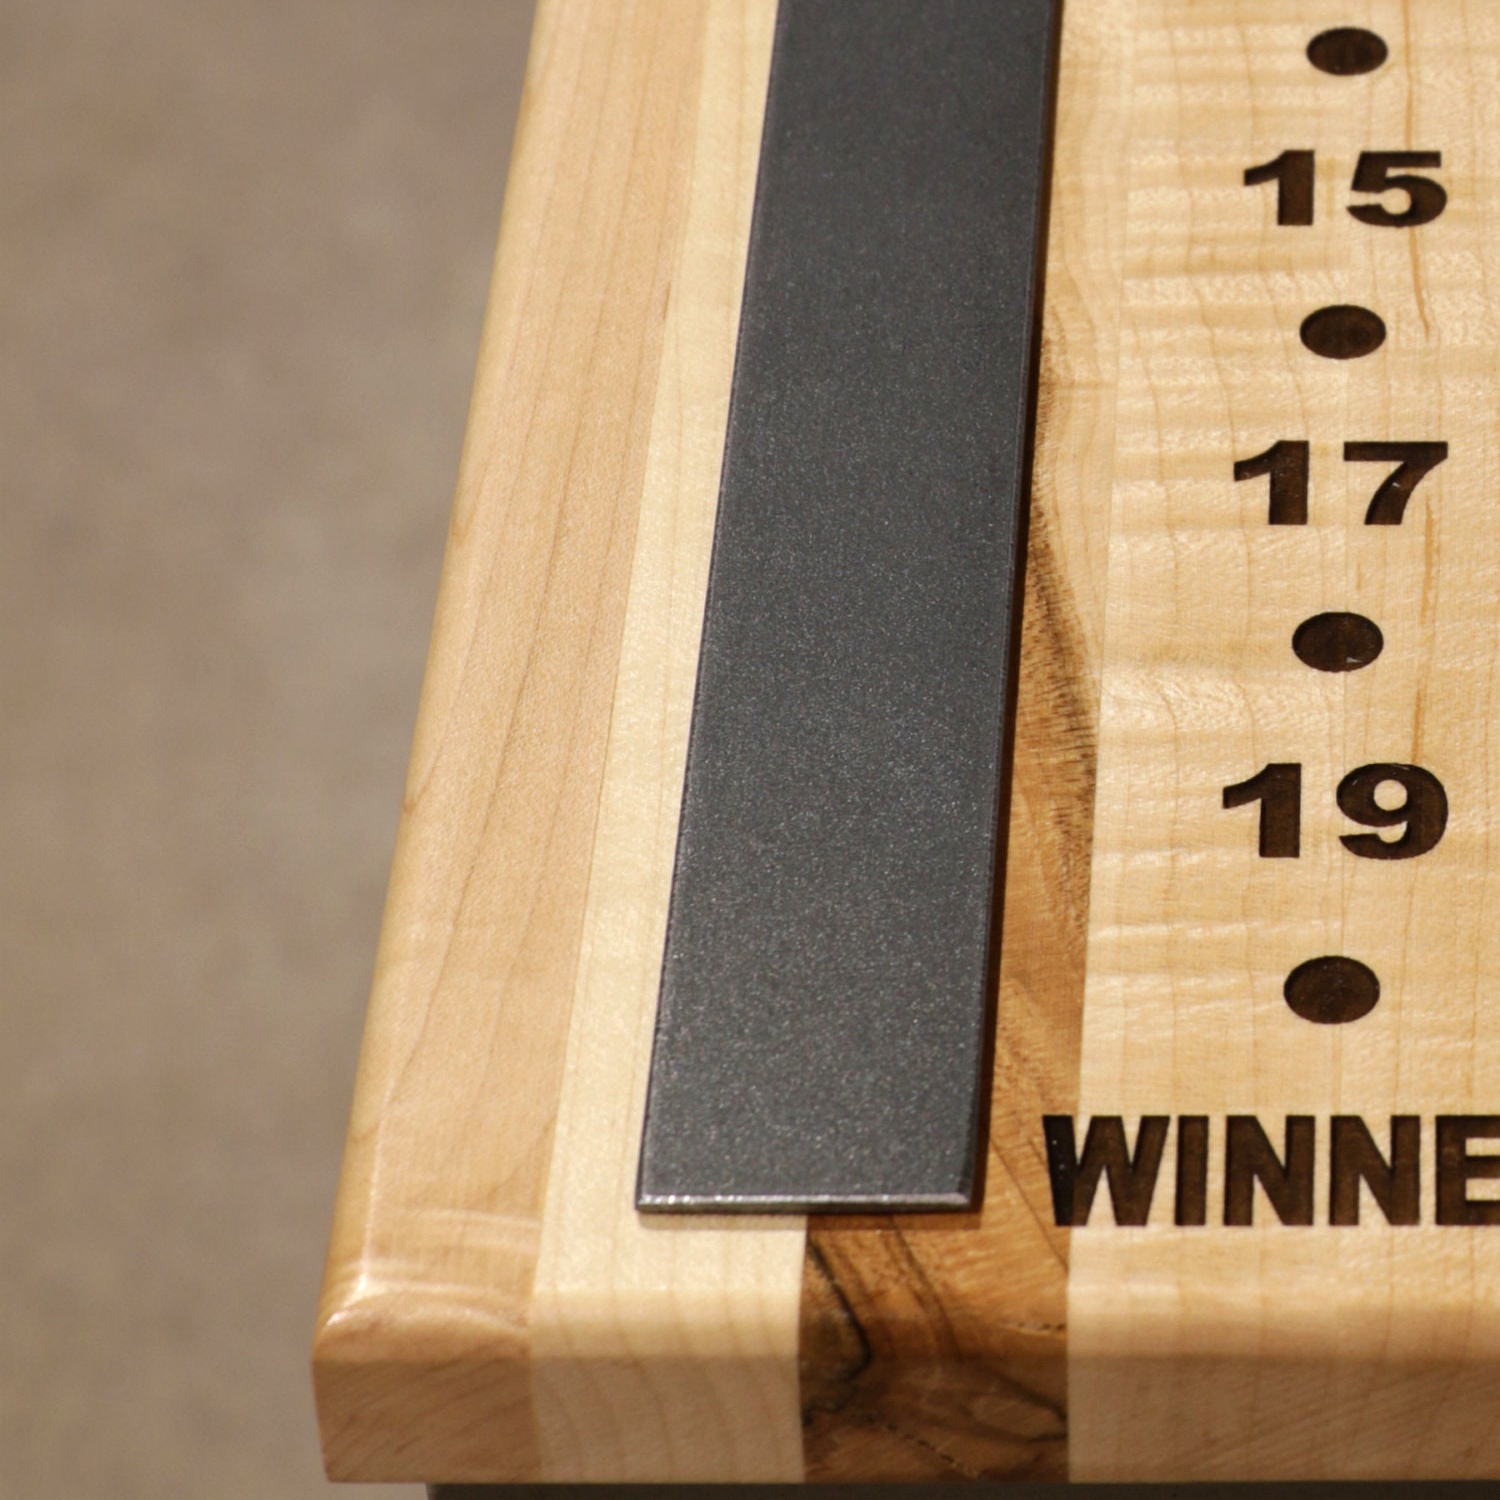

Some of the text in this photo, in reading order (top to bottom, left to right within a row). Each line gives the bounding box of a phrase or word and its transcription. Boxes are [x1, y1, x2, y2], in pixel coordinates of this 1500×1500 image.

[1244, 150, 1447, 227] 15
[1233, 440, 1448, 525] 17
[1223, 763, 1448, 860] 19
